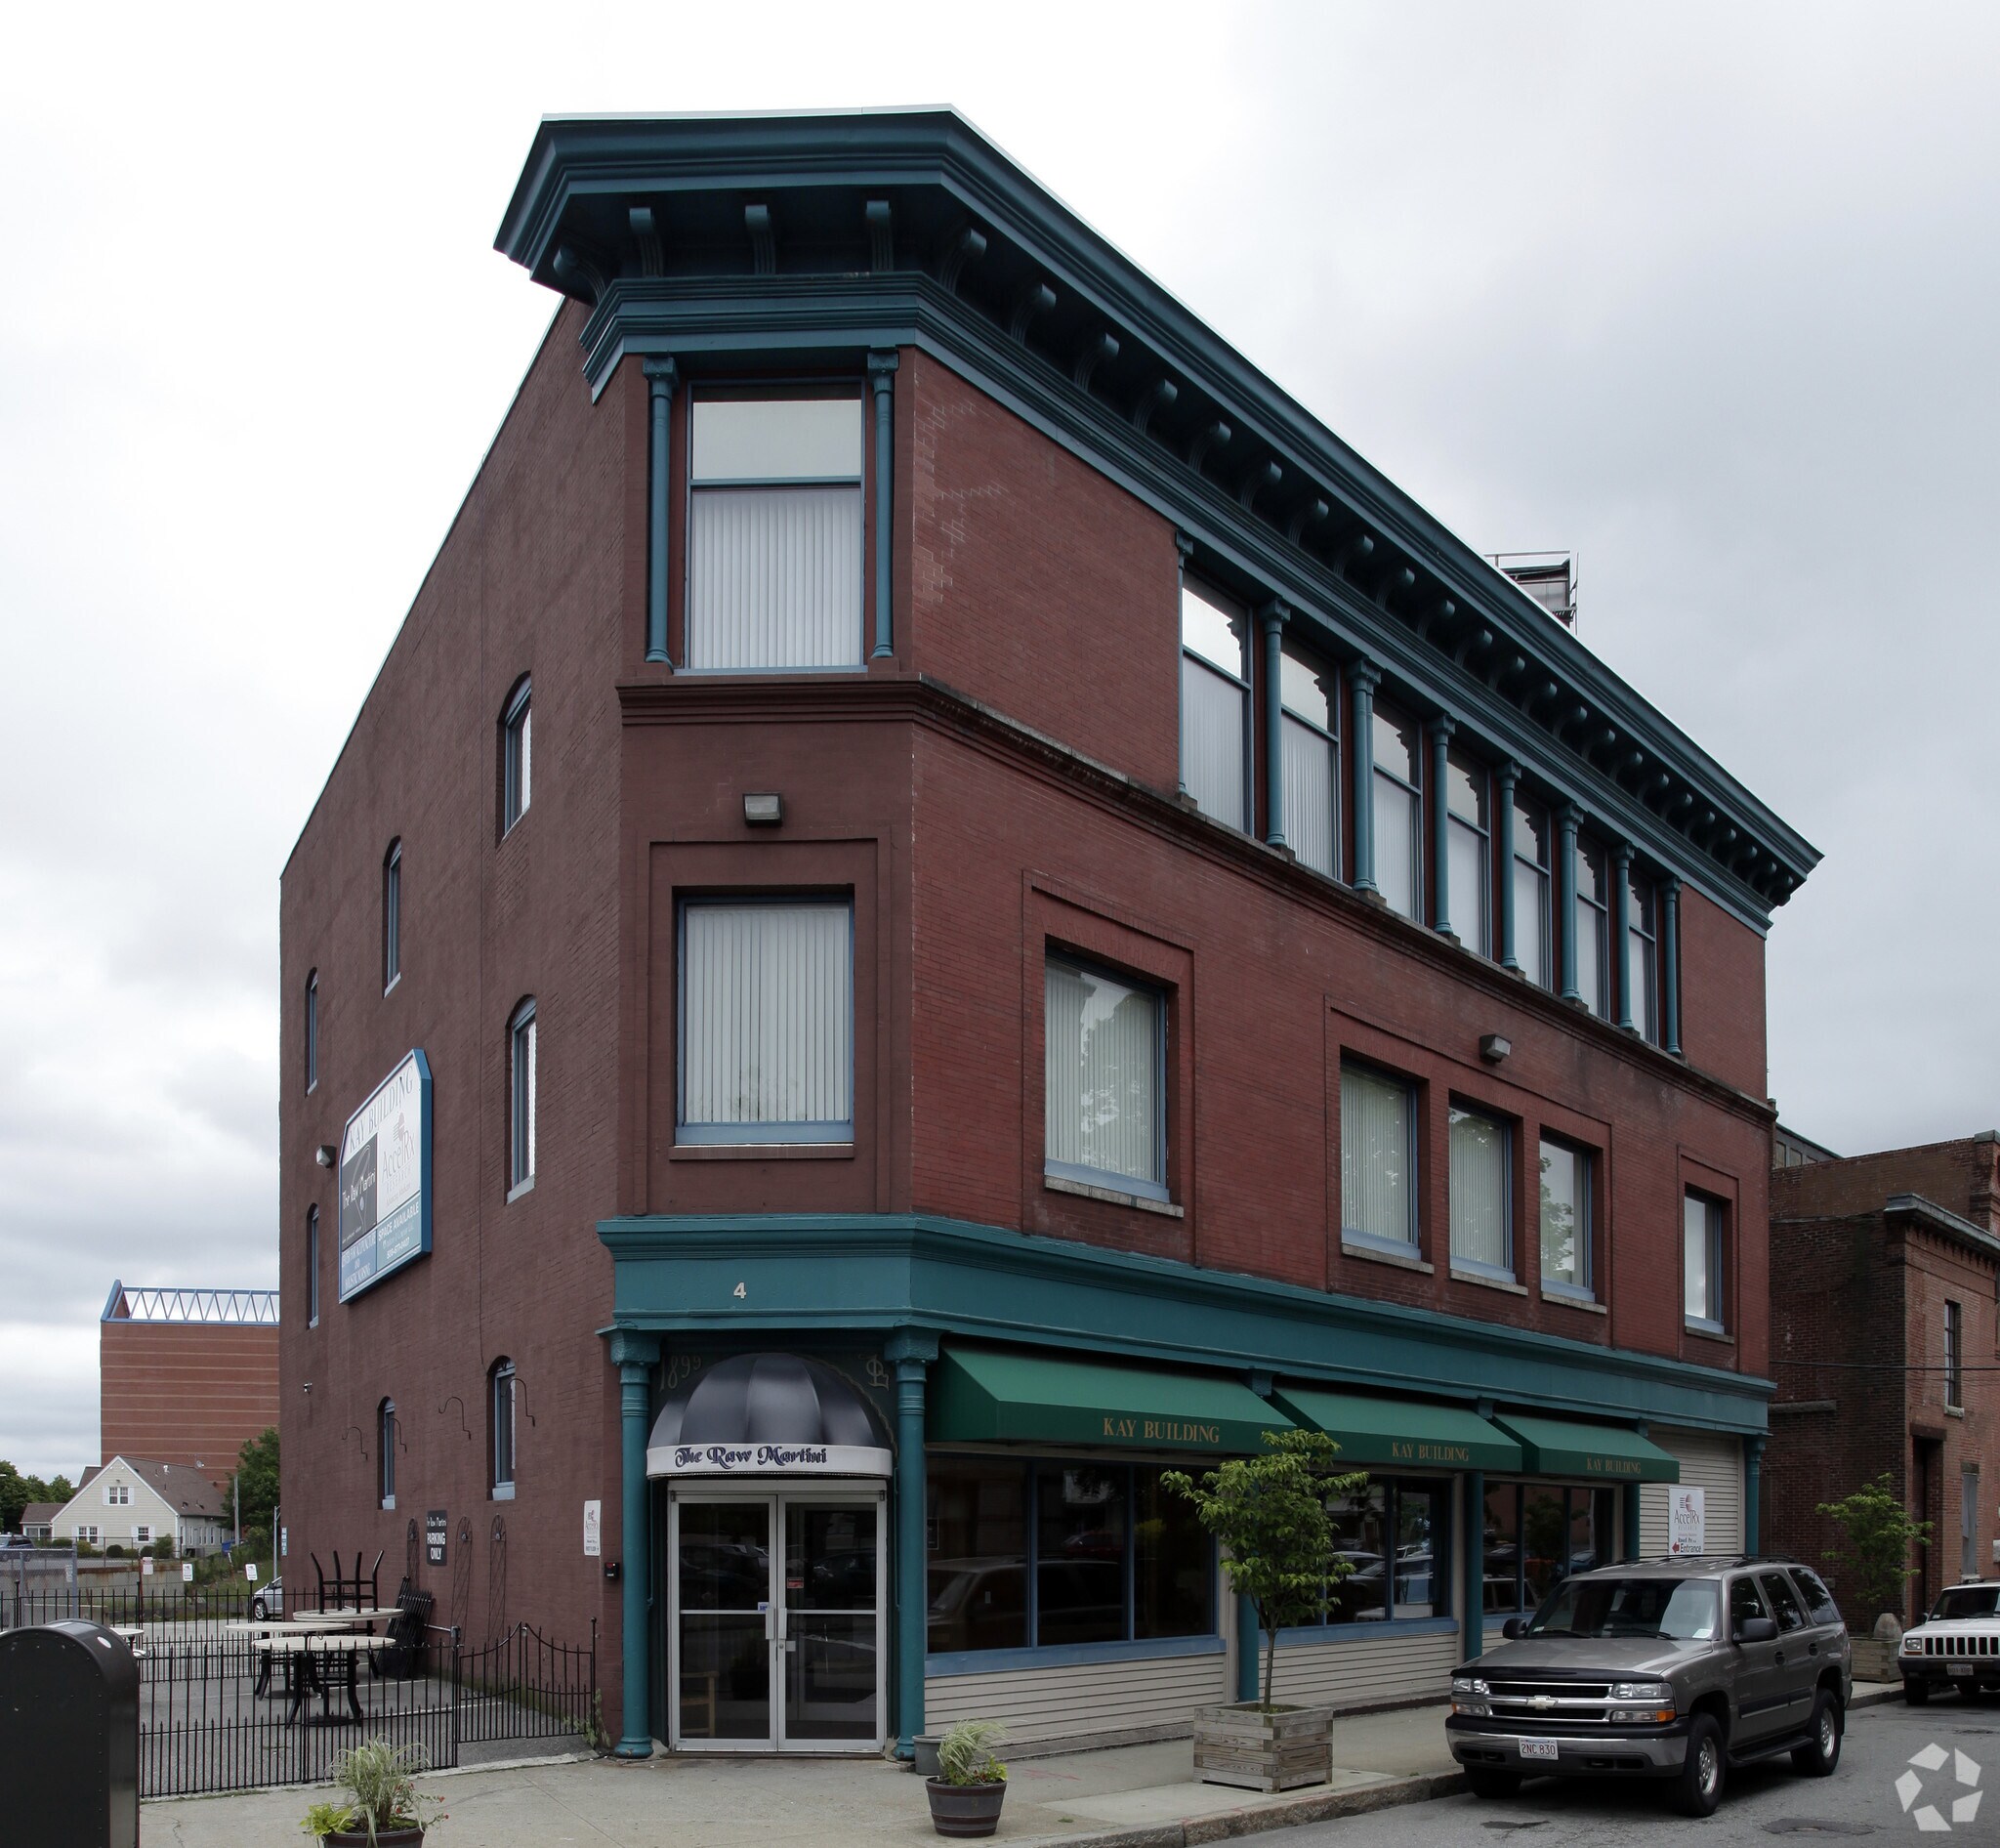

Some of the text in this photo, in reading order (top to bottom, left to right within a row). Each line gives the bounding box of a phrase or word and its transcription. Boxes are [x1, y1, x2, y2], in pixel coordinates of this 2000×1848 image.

[350, 1066, 413, 1153] KAY BUILDING
[378, 1221, 393, 1241] SPACE
[394, 1201, 419, 1231] AVAILABLE
[733, 1281, 747, 1299] 4
[659, 1354, 702, 1393] 1899
[1103, 1417, 1220, 1444] KAY BUILDING
[675, 1445, 827, 1470] The Raw Martini
[1392, 1441, 1469, 1461] KAY BUILDING
[1587, 1456, 1641, 1474] KAY BUILDING
[1674, 1509, 1700, 1524] AccelRx
[427, 1532, 445, 1544] PARKING
[430, 1547, 441, 1560] ONLY
[1680, 1543, 1701, 1553] Entrance
[1521, 1743, 1556, 1755] 2NC 830
